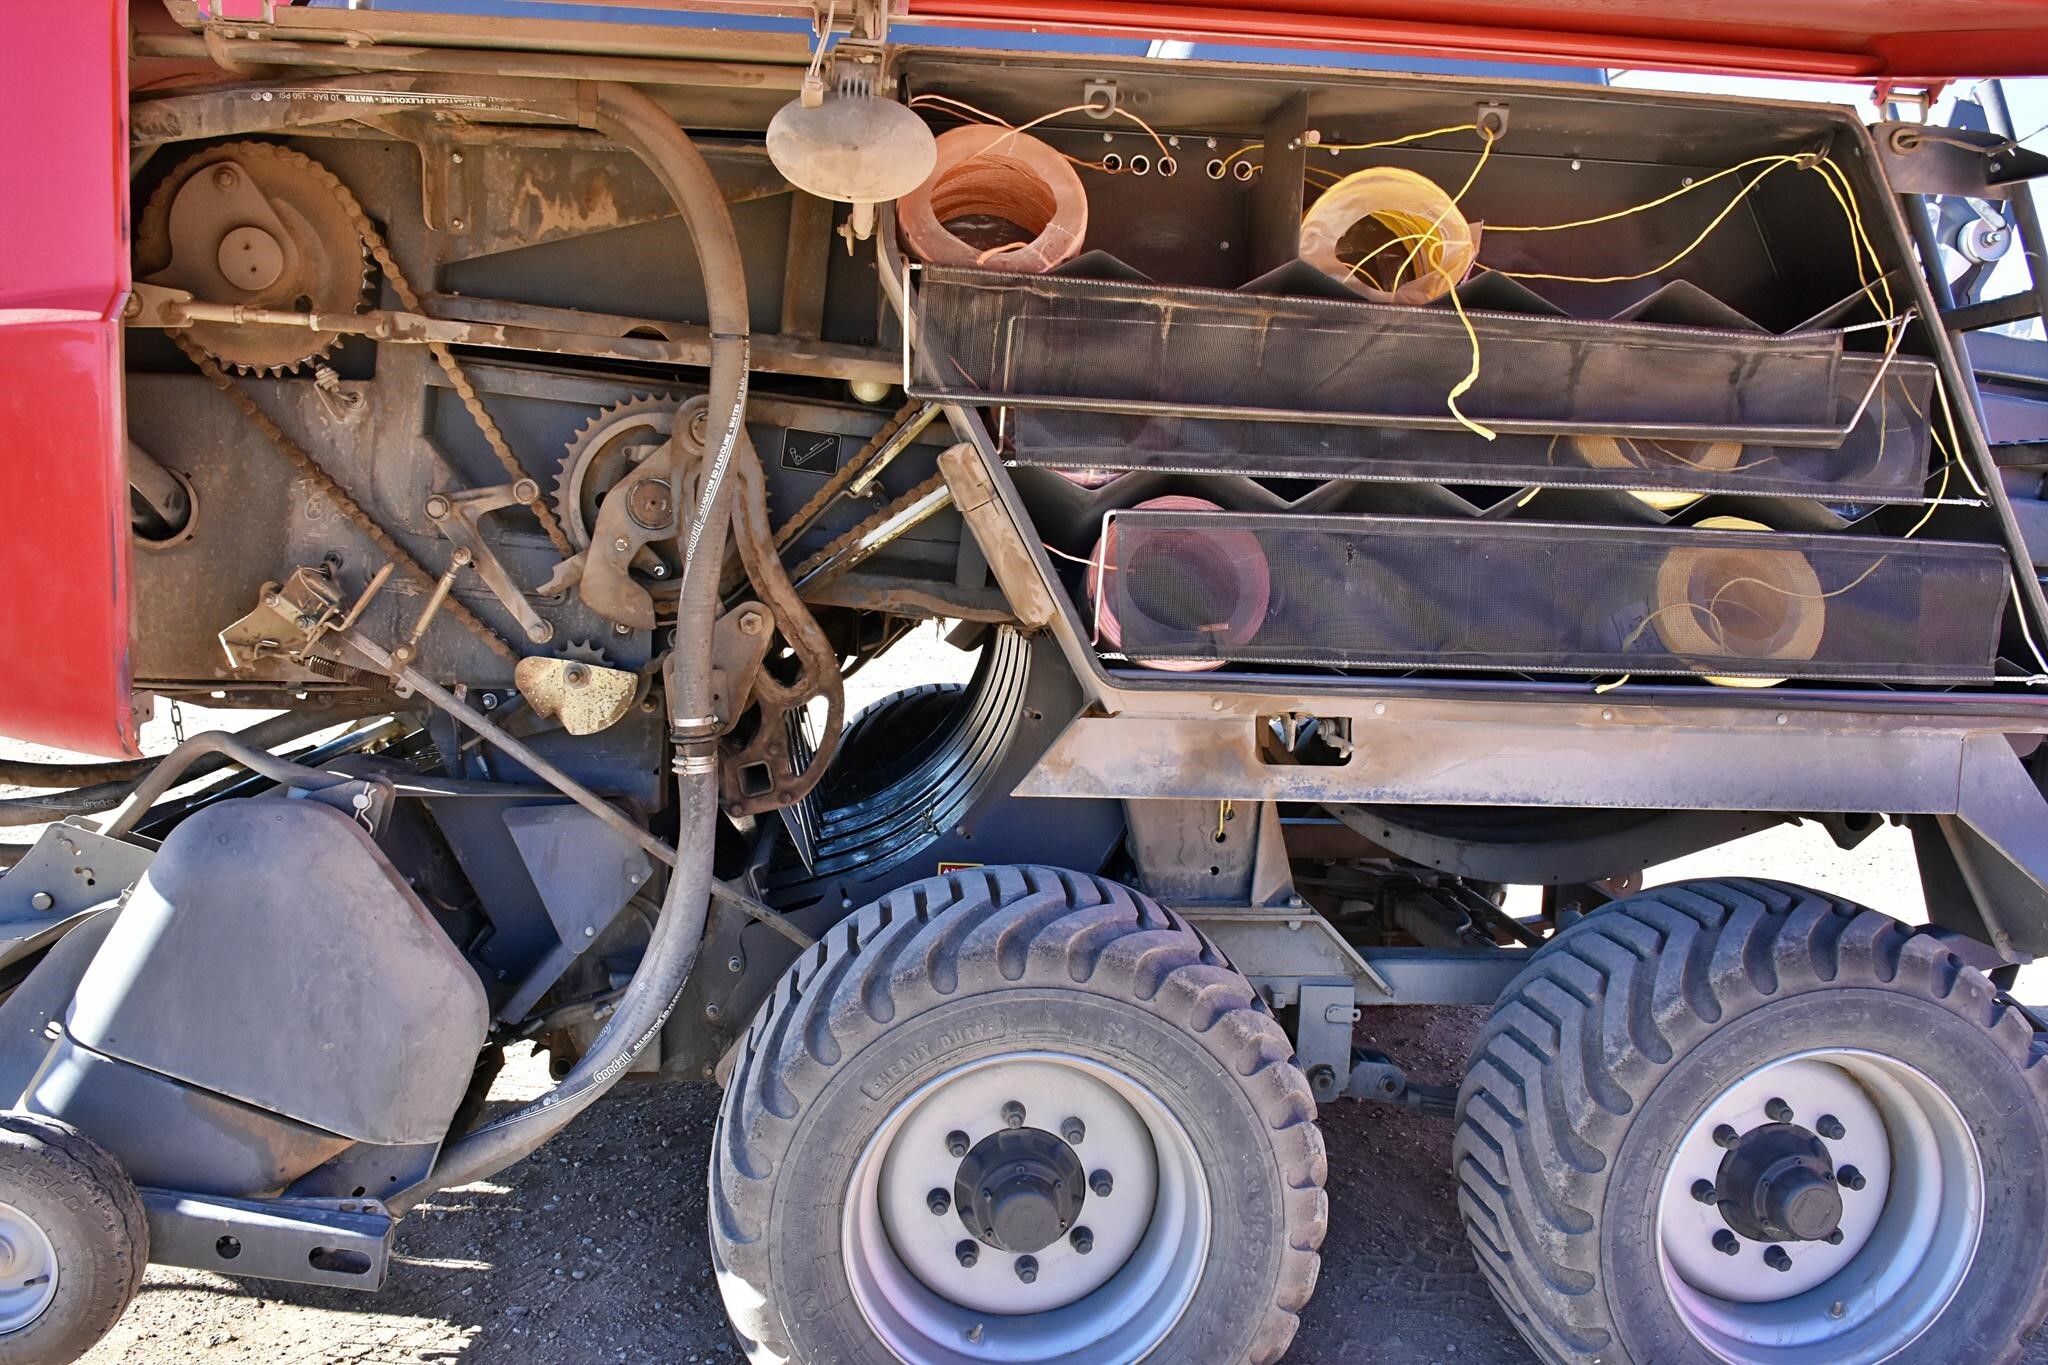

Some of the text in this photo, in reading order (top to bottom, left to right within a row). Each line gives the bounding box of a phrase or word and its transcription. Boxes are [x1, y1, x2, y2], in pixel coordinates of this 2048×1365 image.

[279, 91, 291, 99] PSI
[292, 92, 306, 100] 150
[312, 92, 329, 101] BAR
[330, 93, 340, 101] 10
[345, 94, 374, 103] WATER
[381, 96, 424, 104] FLEXOLINE
[697, 479, 717, 516] ALLIGATOR
[709, 469, 719, 480] SD
[714, 433, 733, 469] FLEXOLINE
[728, 403, 742, 428] WATER
[738, 376, 747, 391] BAR
[593, 1050, 632, 1085] Goodall
[633, 1016, 663, 1051] ALLIGATOR
[659, 1009, 670, 1021] SD
[876, 1022, 986, 1087] HEAVY DUTY
[519, 1107, 530, 1116] 150
[530, 1104, 540, 1113] PSI
